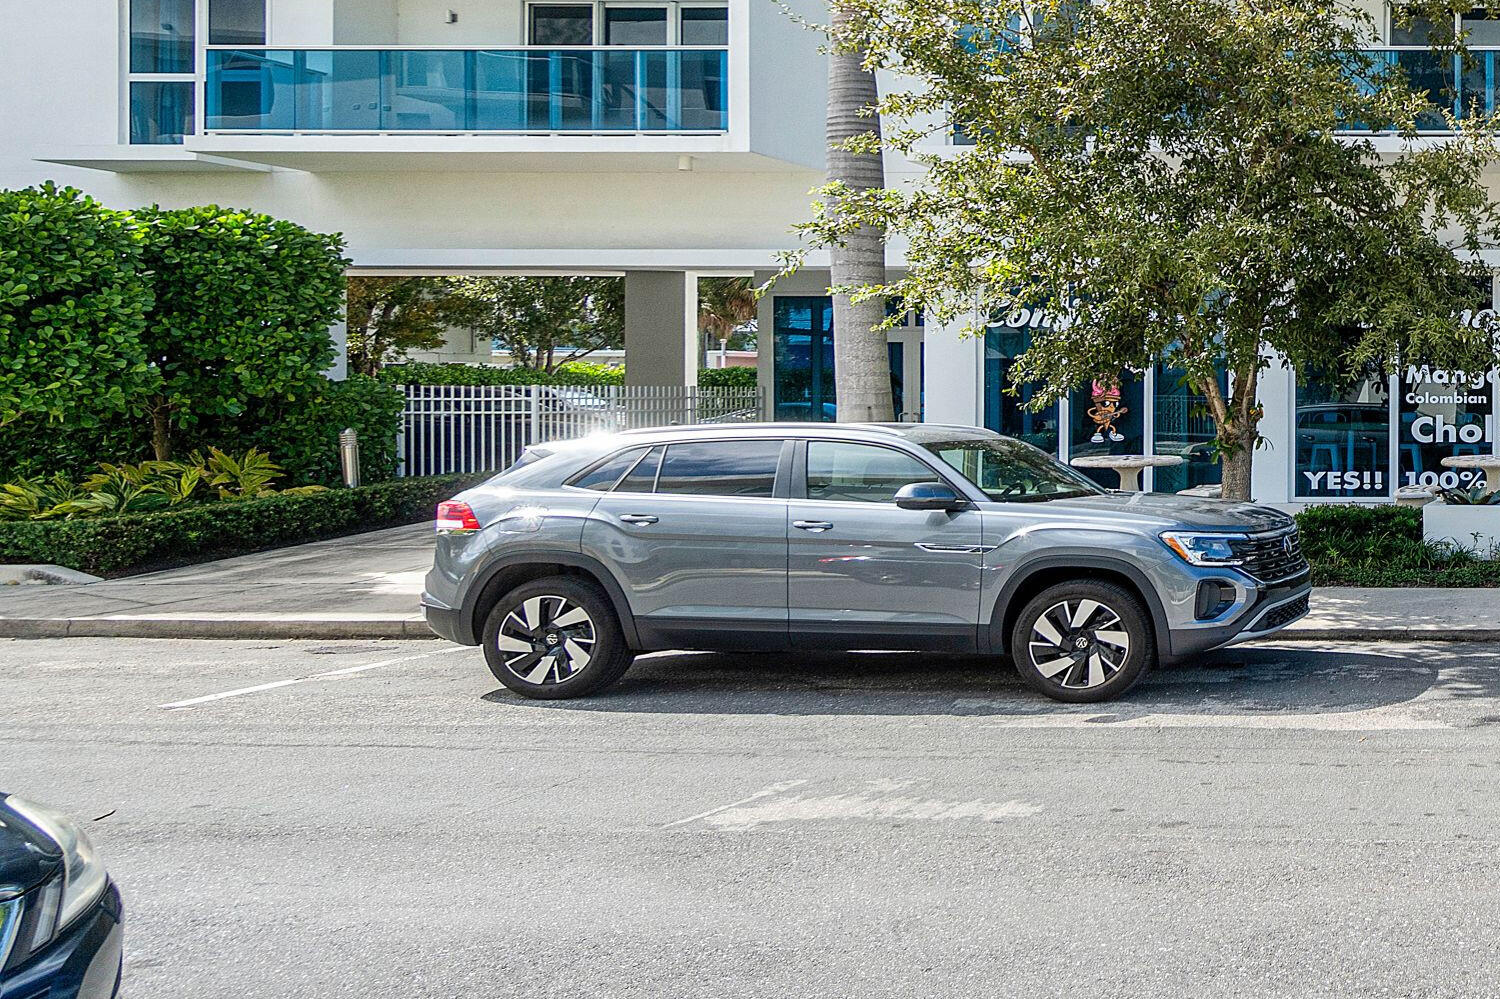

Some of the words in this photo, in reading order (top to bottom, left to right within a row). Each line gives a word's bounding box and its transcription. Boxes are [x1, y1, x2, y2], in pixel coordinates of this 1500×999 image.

[1405, 391, 1487, 404] Colombian
[1303, 471, 1383, 490] YES!!
[1405, 471, 1488, 490] 100%
